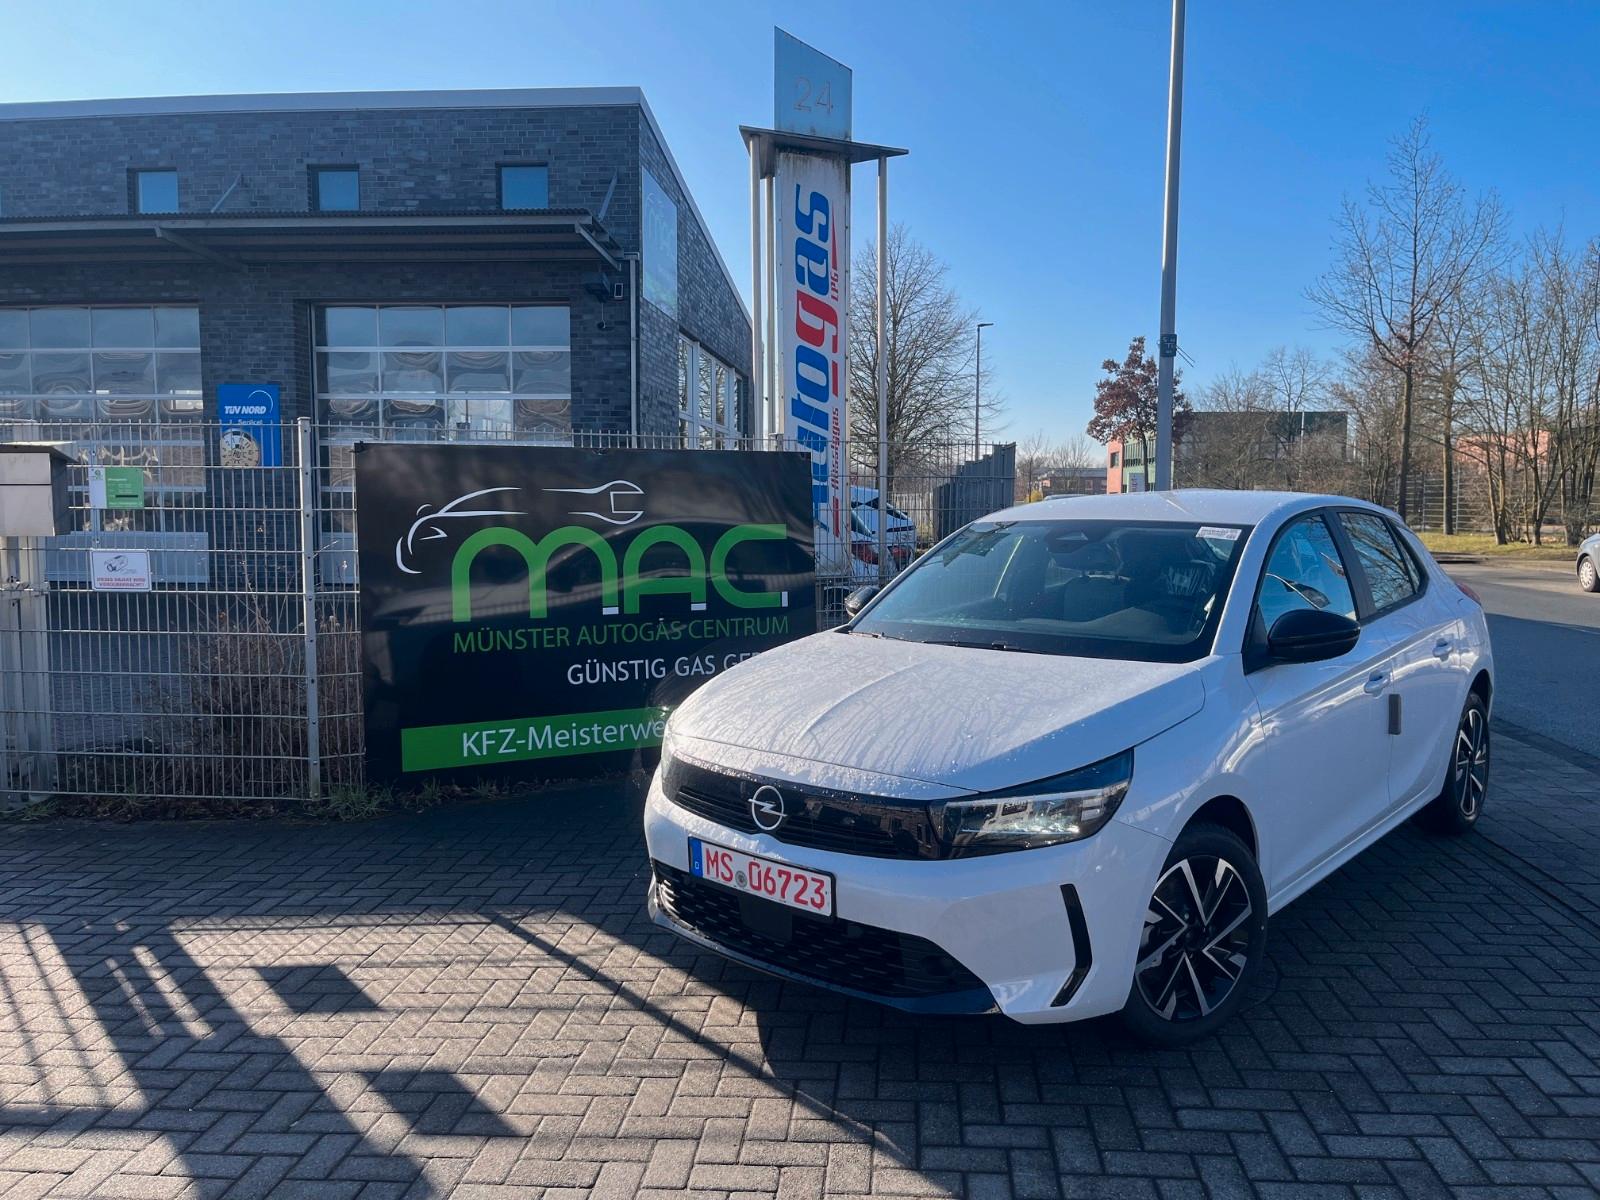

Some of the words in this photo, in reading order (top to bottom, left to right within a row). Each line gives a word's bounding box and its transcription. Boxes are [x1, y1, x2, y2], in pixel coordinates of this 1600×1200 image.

[794, 76, 832, 114] 24
[241, 405, 267, 415] NORD
[453, 627, 570, 653] MÜNSTER
[576, 620, 683, 645] AUTOGAS
[688, 615, 790, 639] CENTRUM
[567, 658, 667, 685] GÜNSTIG
[674, 655, 716, 677] GAS
[705, 848, 734, 882] MS
[748, 861, 826, 910] 06723
